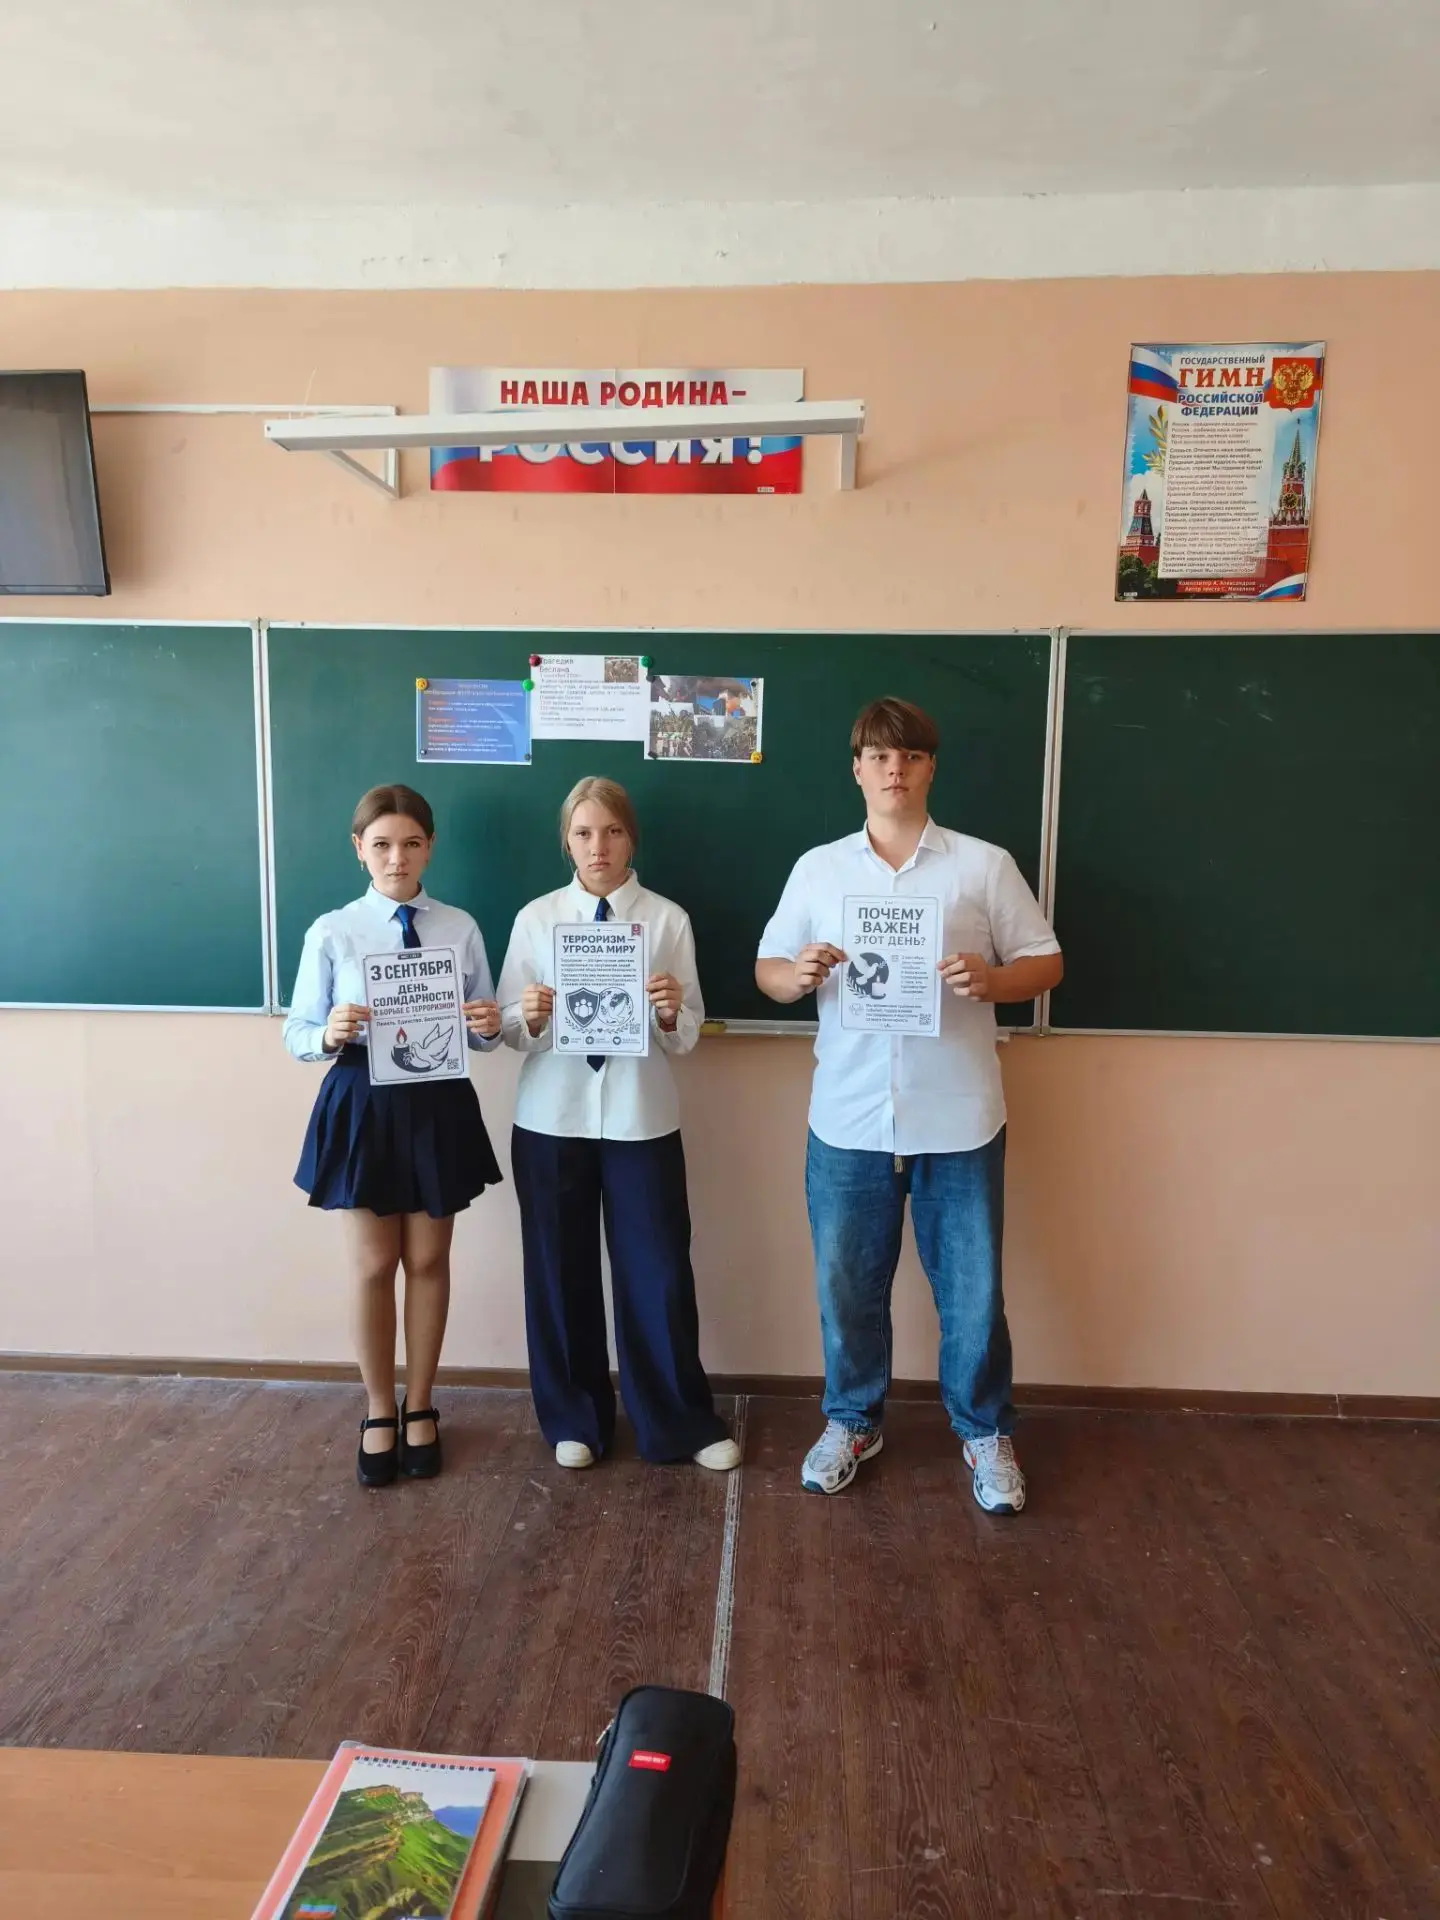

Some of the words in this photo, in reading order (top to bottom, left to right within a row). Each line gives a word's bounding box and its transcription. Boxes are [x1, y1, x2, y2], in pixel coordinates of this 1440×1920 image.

[1181, 354, 1265, 365] ГОСУДАРСТВЕННЫЙ
[1178, 367, 1265, 387] ГИМН
[501, 381, 589, 405] НАША
[1178, 391, 1263, 403] РОССИЙСКОЙ
[1181, 406, 1258, 417] ФЕДЕРАЦИИ
[858, 907, 924, 920] ПОЧЕМУ
[863, 921, 919, 934] ВАЖЕН
[562, 935, 626, 944] ТЕРРОРИЗМ
[854, 935, 884, 945] ЭТОТ
[887, 936, 926, 946] ДЕНЬ?
[562, 945, 604, 954] УГРОЗА
[606, 945, 636, 954] МИРУ
[370, 965, 382, 981] 3
[384, 959, 453, 980] СЕНТЯБРЯ
[398, 983, 428, 995] ДЕНЬ
[373, 990, 454, 1008] СОЛИДАРНОСТИ
[379, 1007, 404, 1016] БОРЬБЕ
[411, 1002, 455, 1013] ТЕРРОРИЗМОМ
